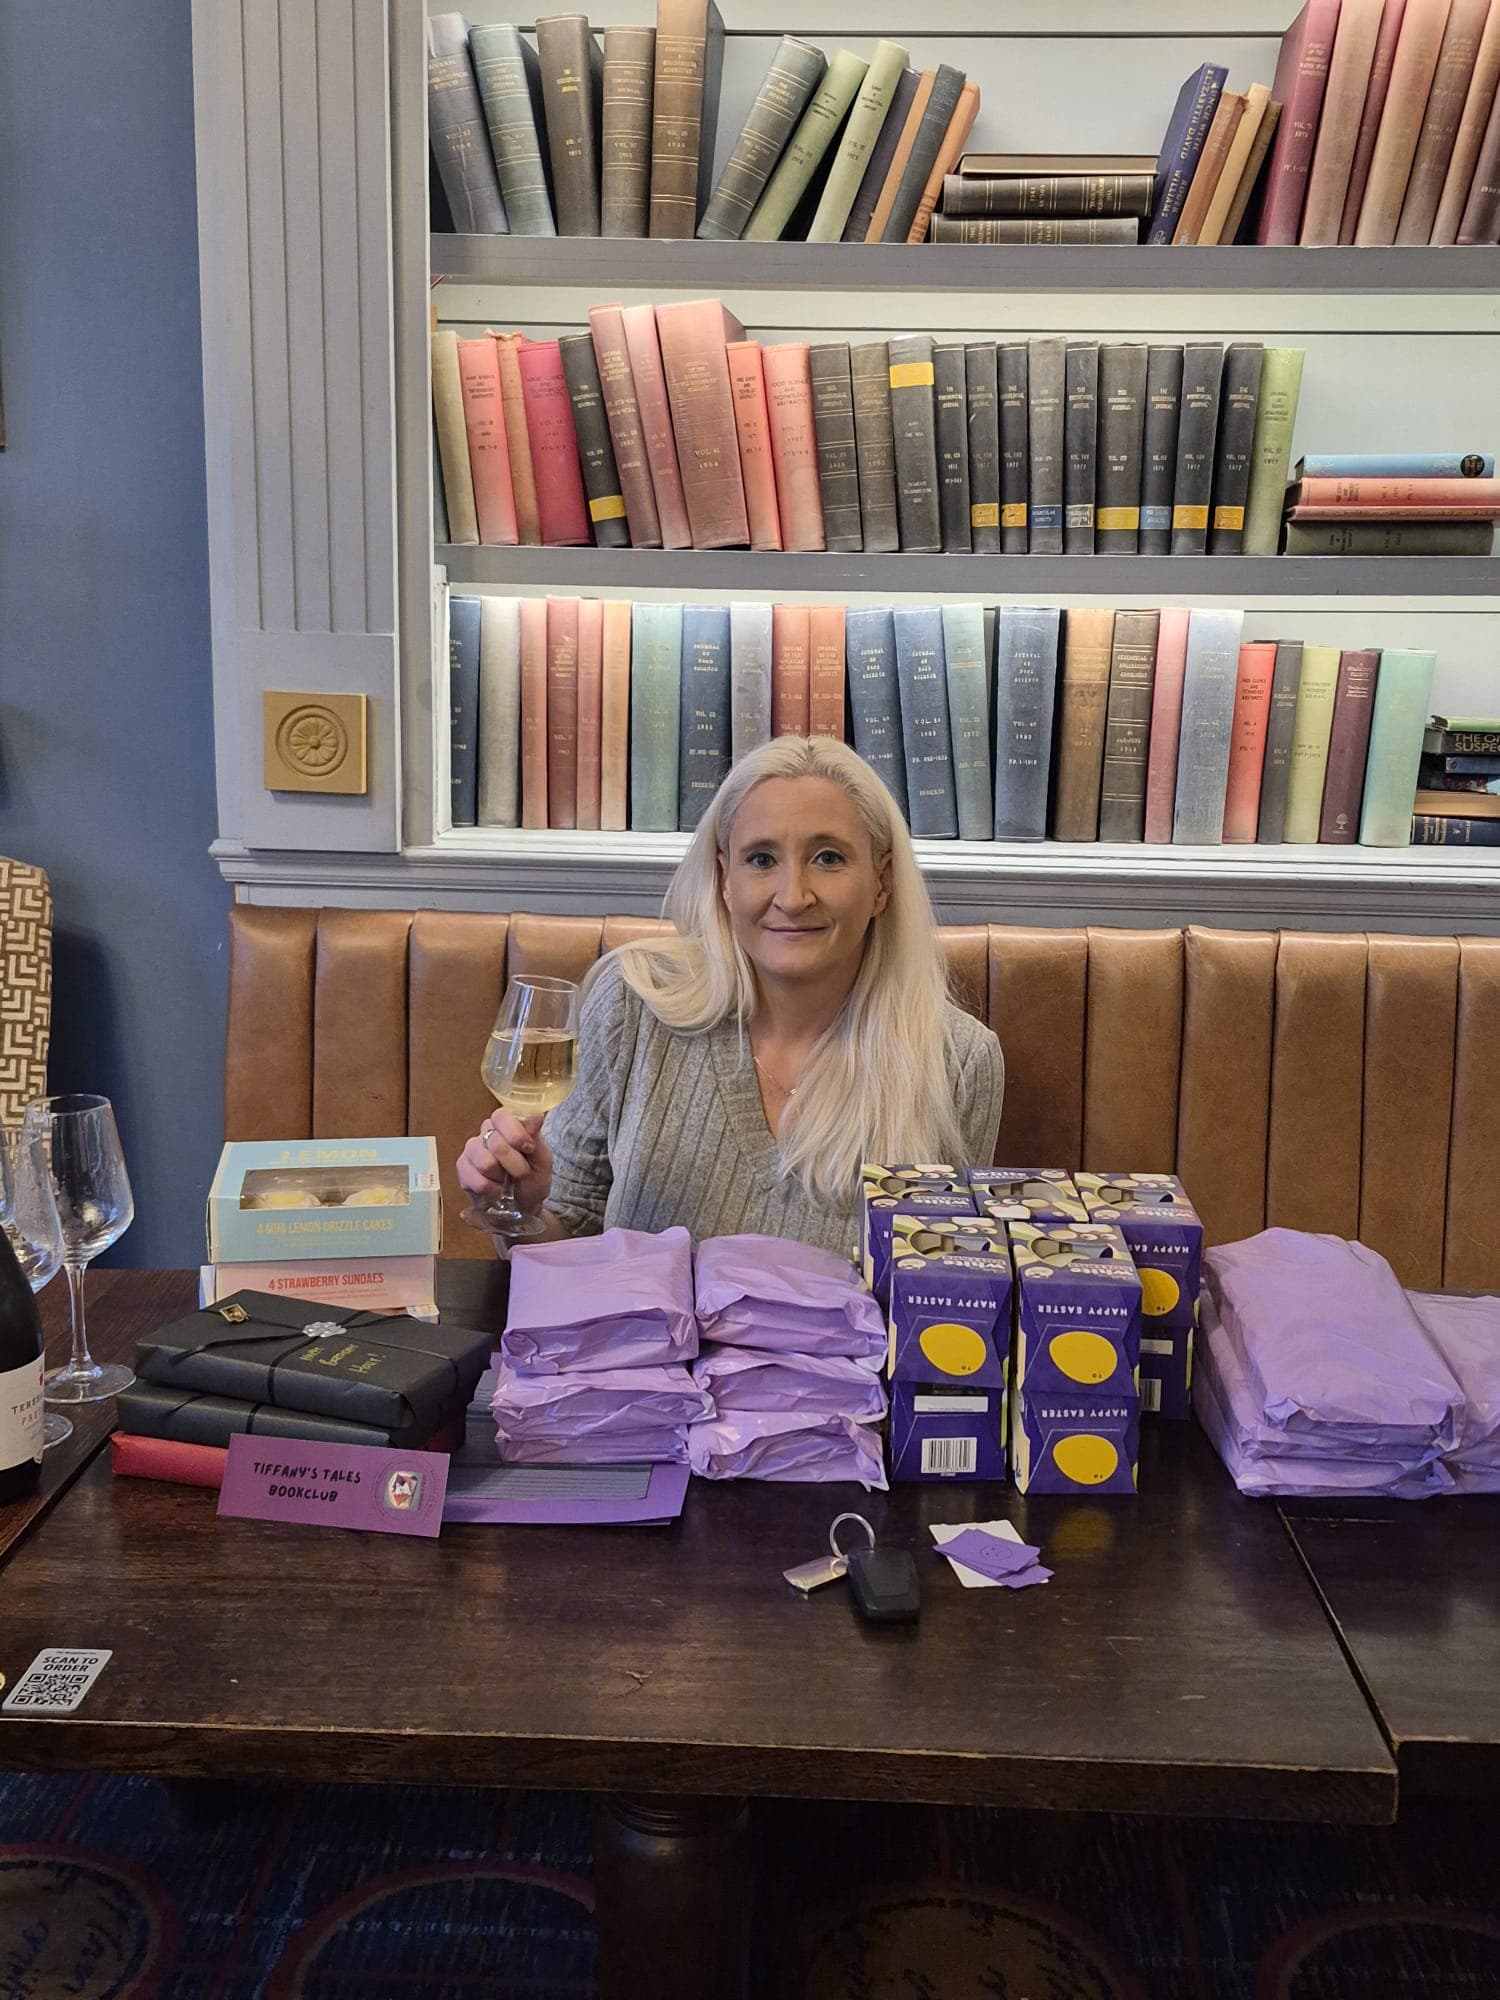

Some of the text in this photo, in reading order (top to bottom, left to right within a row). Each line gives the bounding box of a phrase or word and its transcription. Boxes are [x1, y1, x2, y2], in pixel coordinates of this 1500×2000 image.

[1180, 129, 1196, 160] DAVID
[1161, 168, 1183, 218] WILLIAMS
[1453, 733, 1481, 743] THE
[281, 1149, 377, 1164] LEMON
[256, 1223, 264, 1235] 4
[289, 1220, 321, 1233] LEMON
[363, 1218, 394, 1231] CAKES
[1128, 1244, 1189, 1254] HAPPY EAS
[268, 1272, 384, 1291] 4 STRAWBERRY SUNDAES
[908, 1295, 997, 1309] HAPPY EASTER
[1038, 1304, 1128, 1317] HAPPY EASTER
[1041, 1408, 1128, 1418] HAPPY EASTER
[253, 1461, 361, 1484] TIFFANY'S TALES
[268, 1484, 338, 1503] BOOKCLUB
[42, 1656, 99, 1665] SCAN TO
[43, 1664, 89, 1672] ORDER
